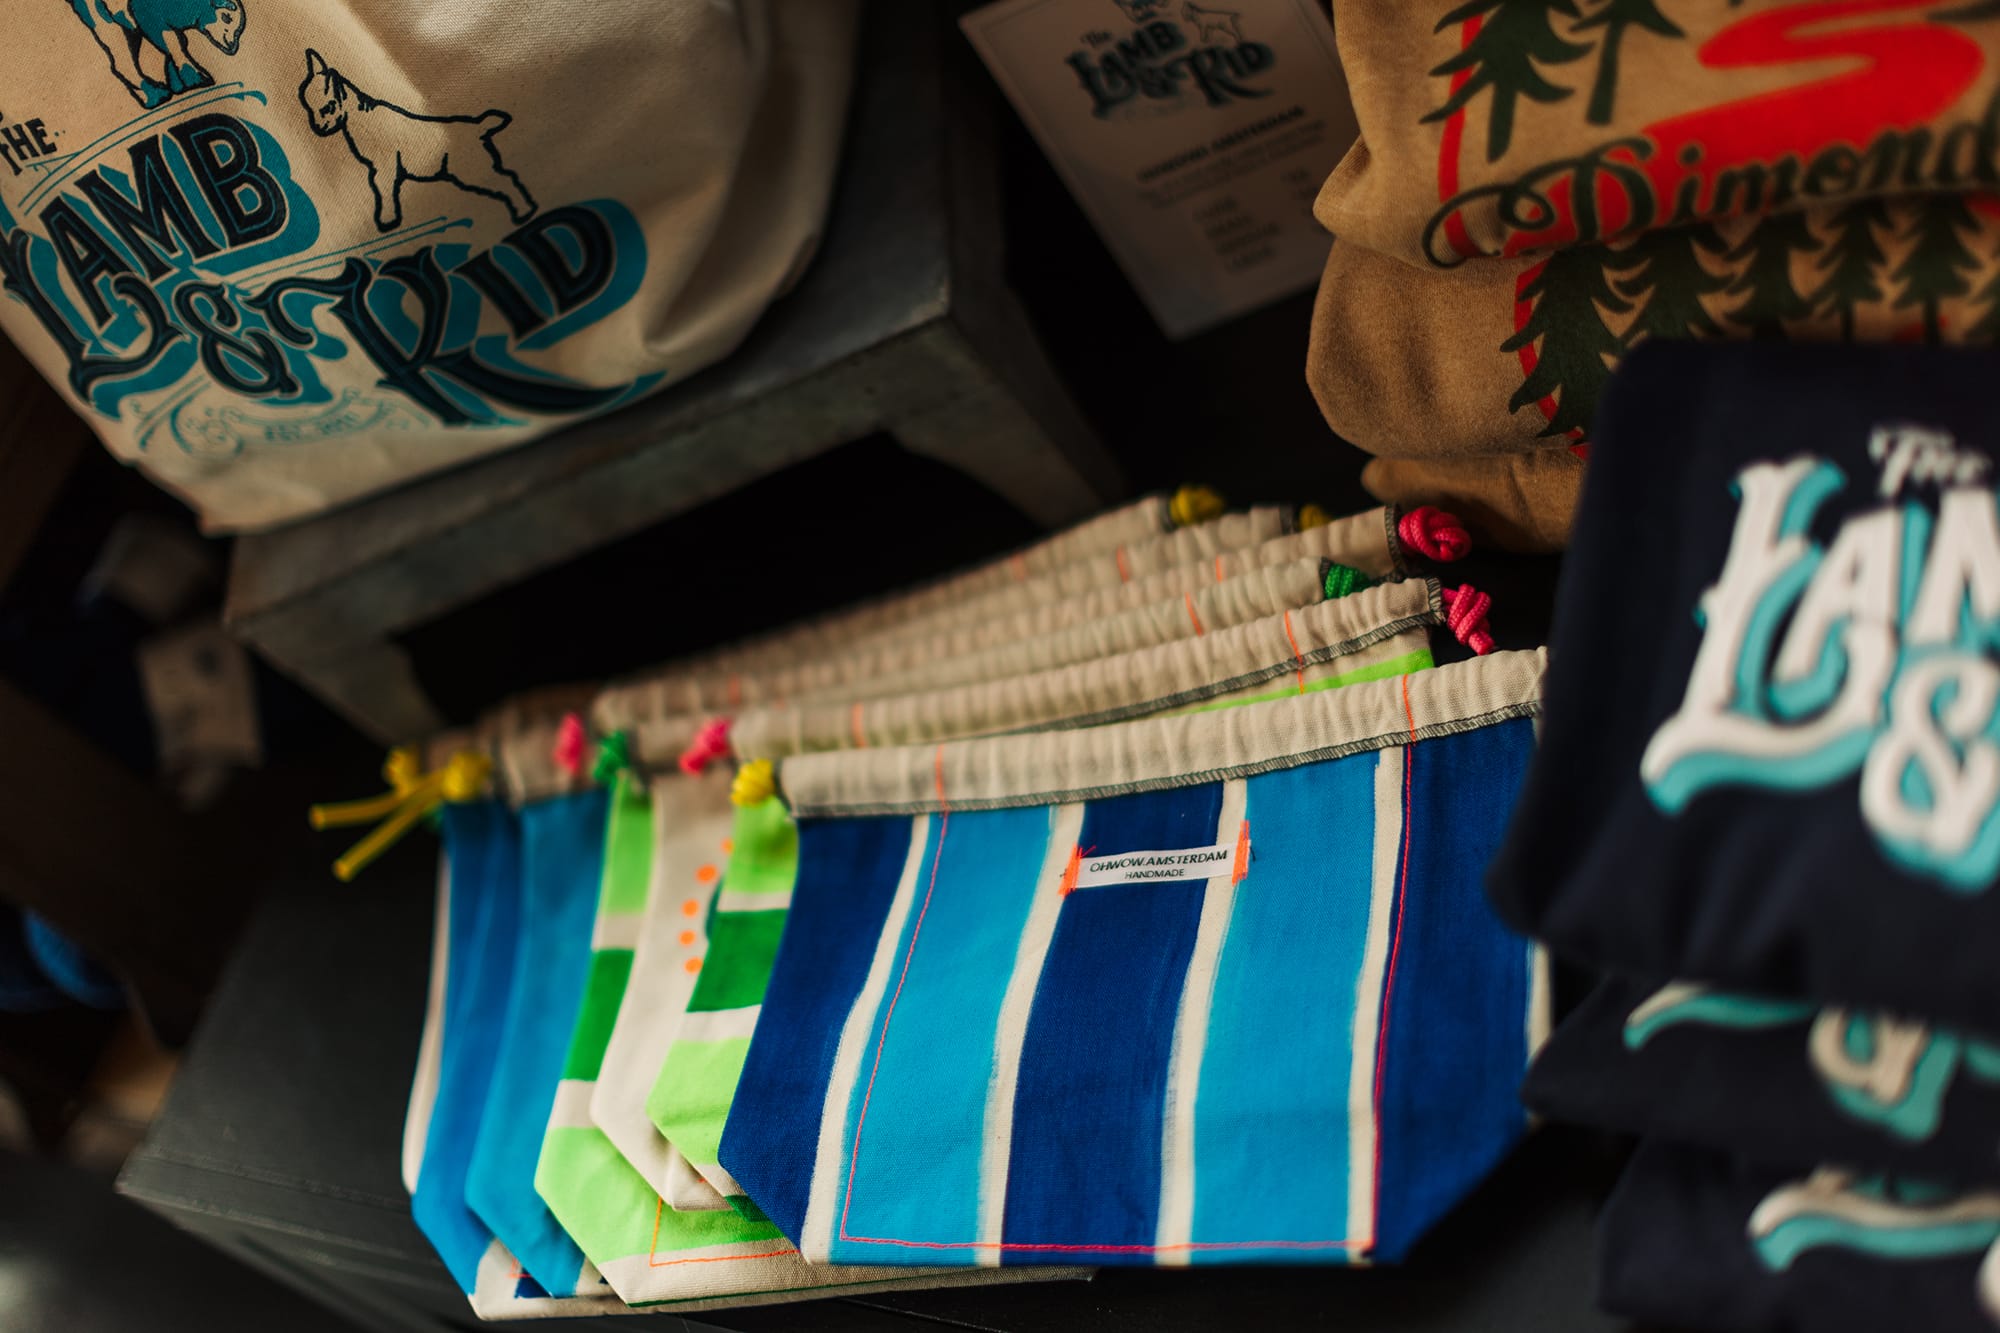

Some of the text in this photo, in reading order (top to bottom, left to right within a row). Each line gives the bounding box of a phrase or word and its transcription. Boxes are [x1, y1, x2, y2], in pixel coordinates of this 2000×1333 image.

[1065, 21, 1186, 120] LAMB
[1168, 41, 1277, 107] KID
[2, 112, 305, 412] LAMB
[172, 203, 645, 428] & KID
[1867, 426, 1993, 498] The
[1089, 849, 1228, 873] OHWOW.AMSTERDAM
[1125, 868, 1185, 880] HANDMADE
